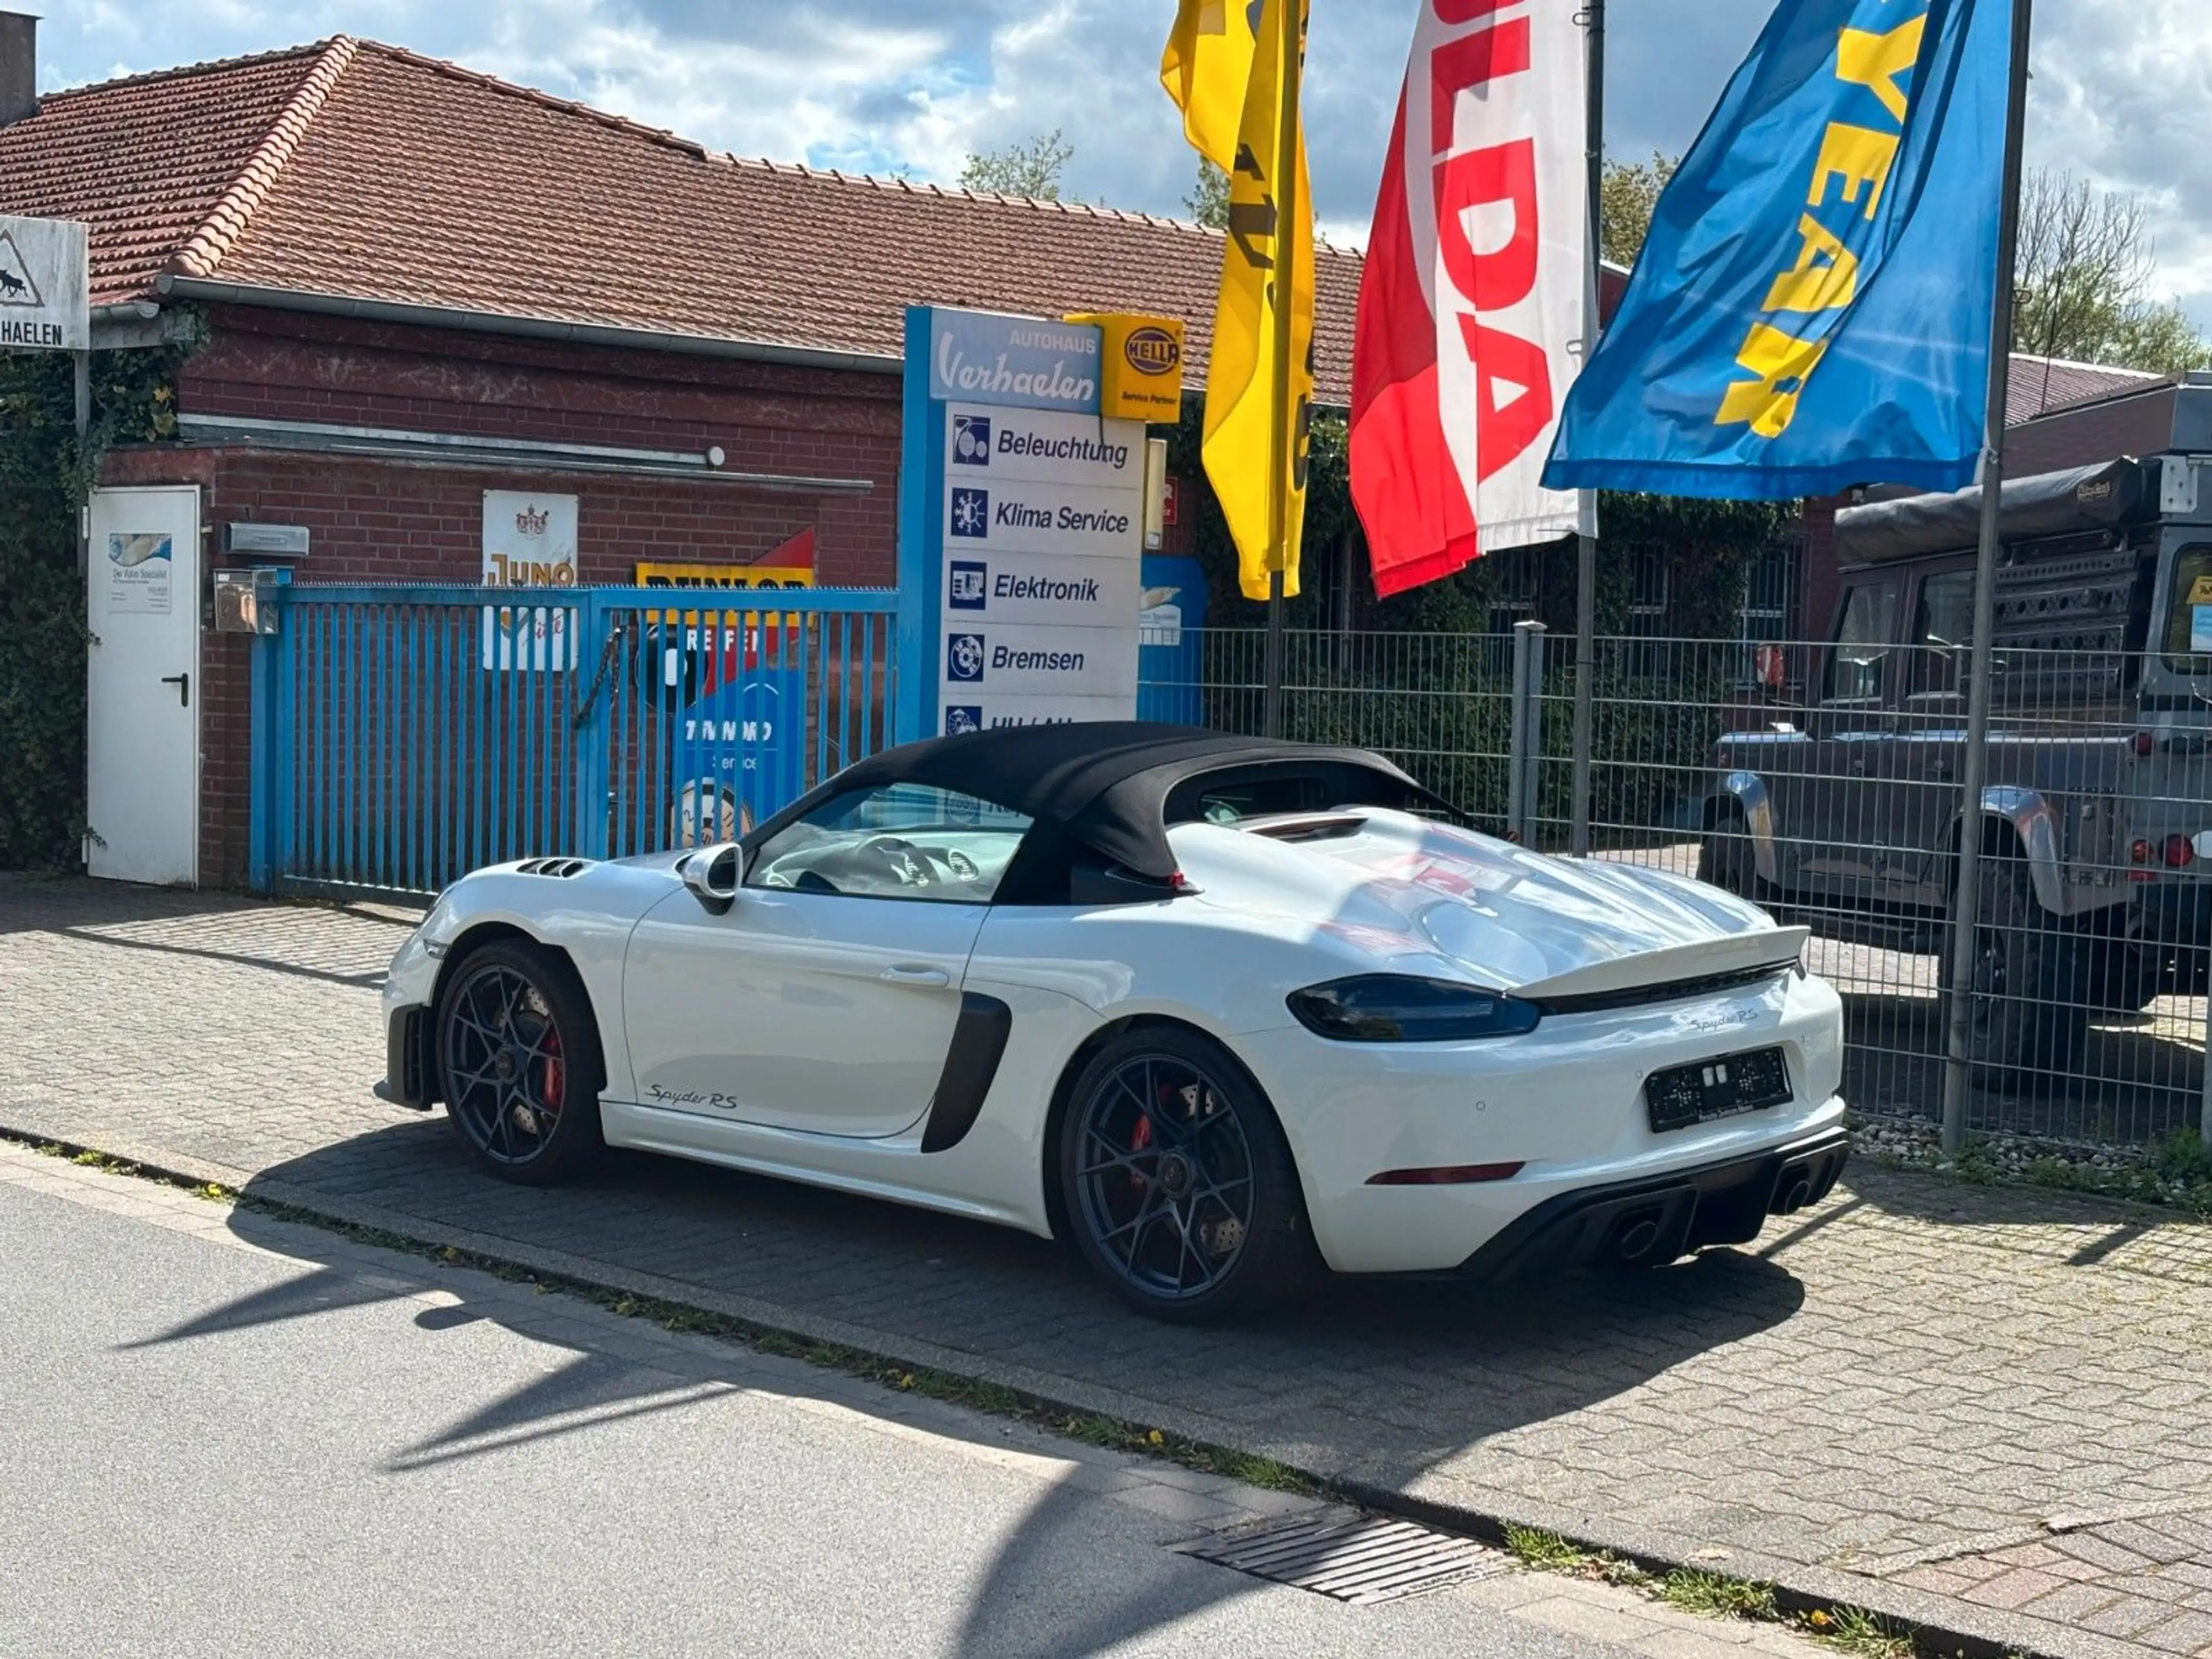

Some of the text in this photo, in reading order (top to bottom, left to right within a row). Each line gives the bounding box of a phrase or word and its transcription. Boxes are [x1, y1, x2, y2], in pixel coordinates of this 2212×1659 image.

[1713, 10, 1928, 439] YEAR
[2, 320, 62, 346] HAELEN
[1009, 329, 1096, 355] AUTOHAUS
[1128, 340, 1179, 364] HELLA
[938, 331, 1094, 401] Verhaelen
[998, 429, 1128, 469] Beleuchtung
[995, 502, 1129, 533] Klima Service
[994, 574, 1099, 601] Elektronik
[992, 645, 1085, 671] Bremsen
[1735, 1009, 1759, 1022] RS
[644, 1084, 737, 1109] Spyder RS
